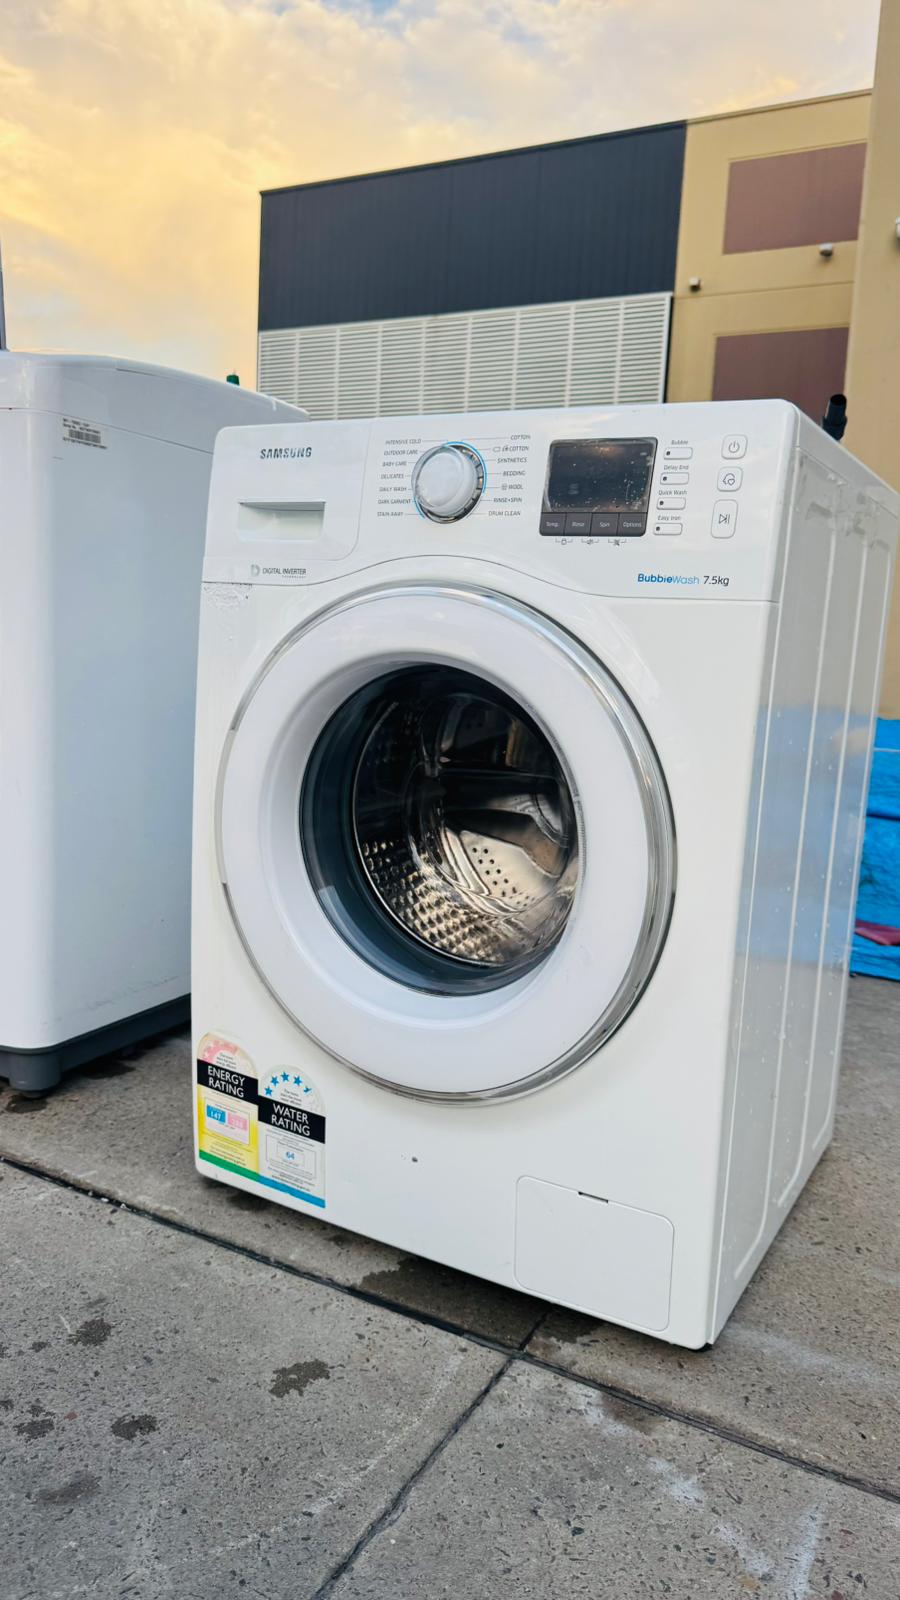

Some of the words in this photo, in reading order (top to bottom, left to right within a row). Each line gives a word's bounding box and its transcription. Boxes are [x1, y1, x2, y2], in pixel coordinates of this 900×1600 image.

[260, 447, 312, 459] SAMSUNG
[262, 567, 281, 575] DIGITAL
[282, 567, 307, 575] INVERTER
[703, 575, 730, 587] 7.5kg
[208, 1065, 245, 1087] ENERGY
[208, 1077, 244, 1098] RATING
[273, 1103, 309, 1125] WATER
[271, 1114, 310, 1136] RATING
[286, 1151, 295, 1160] 64
